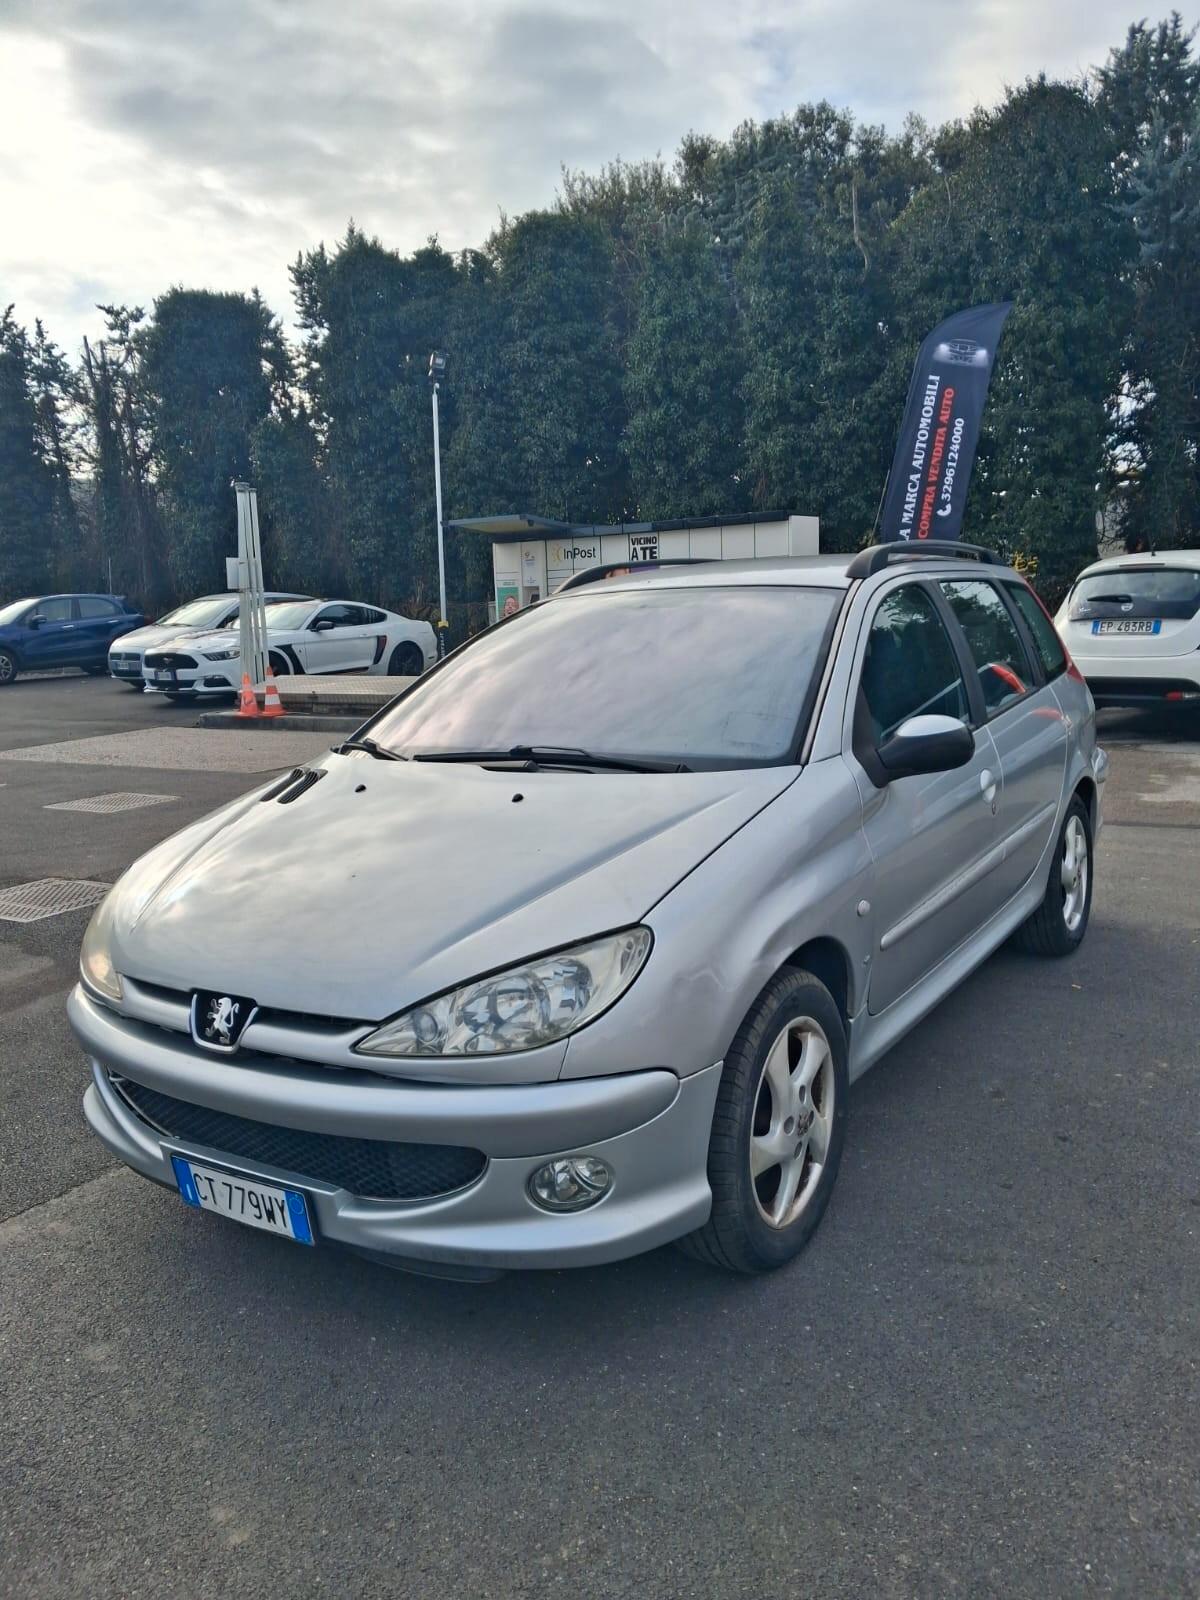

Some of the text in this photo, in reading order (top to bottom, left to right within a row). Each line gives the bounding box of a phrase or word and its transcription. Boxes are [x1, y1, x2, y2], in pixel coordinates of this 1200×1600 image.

[902, 473, 921, 524] MARCA
[912, 374, 940, 470] AUTOMOBILI
[918, 388, 955, 539] COMPRA VENDITA AUTO
[941, 418, 965, 502] 3296124000
[563, 547, 596, 560] InPost
[631, 536, 657, 546] VICINO
[631, 546, 657, 560] A TE
[1100, 621, 1152, 633] EP 483RB
[193, 1173, 287, 1229] CT 779WY
